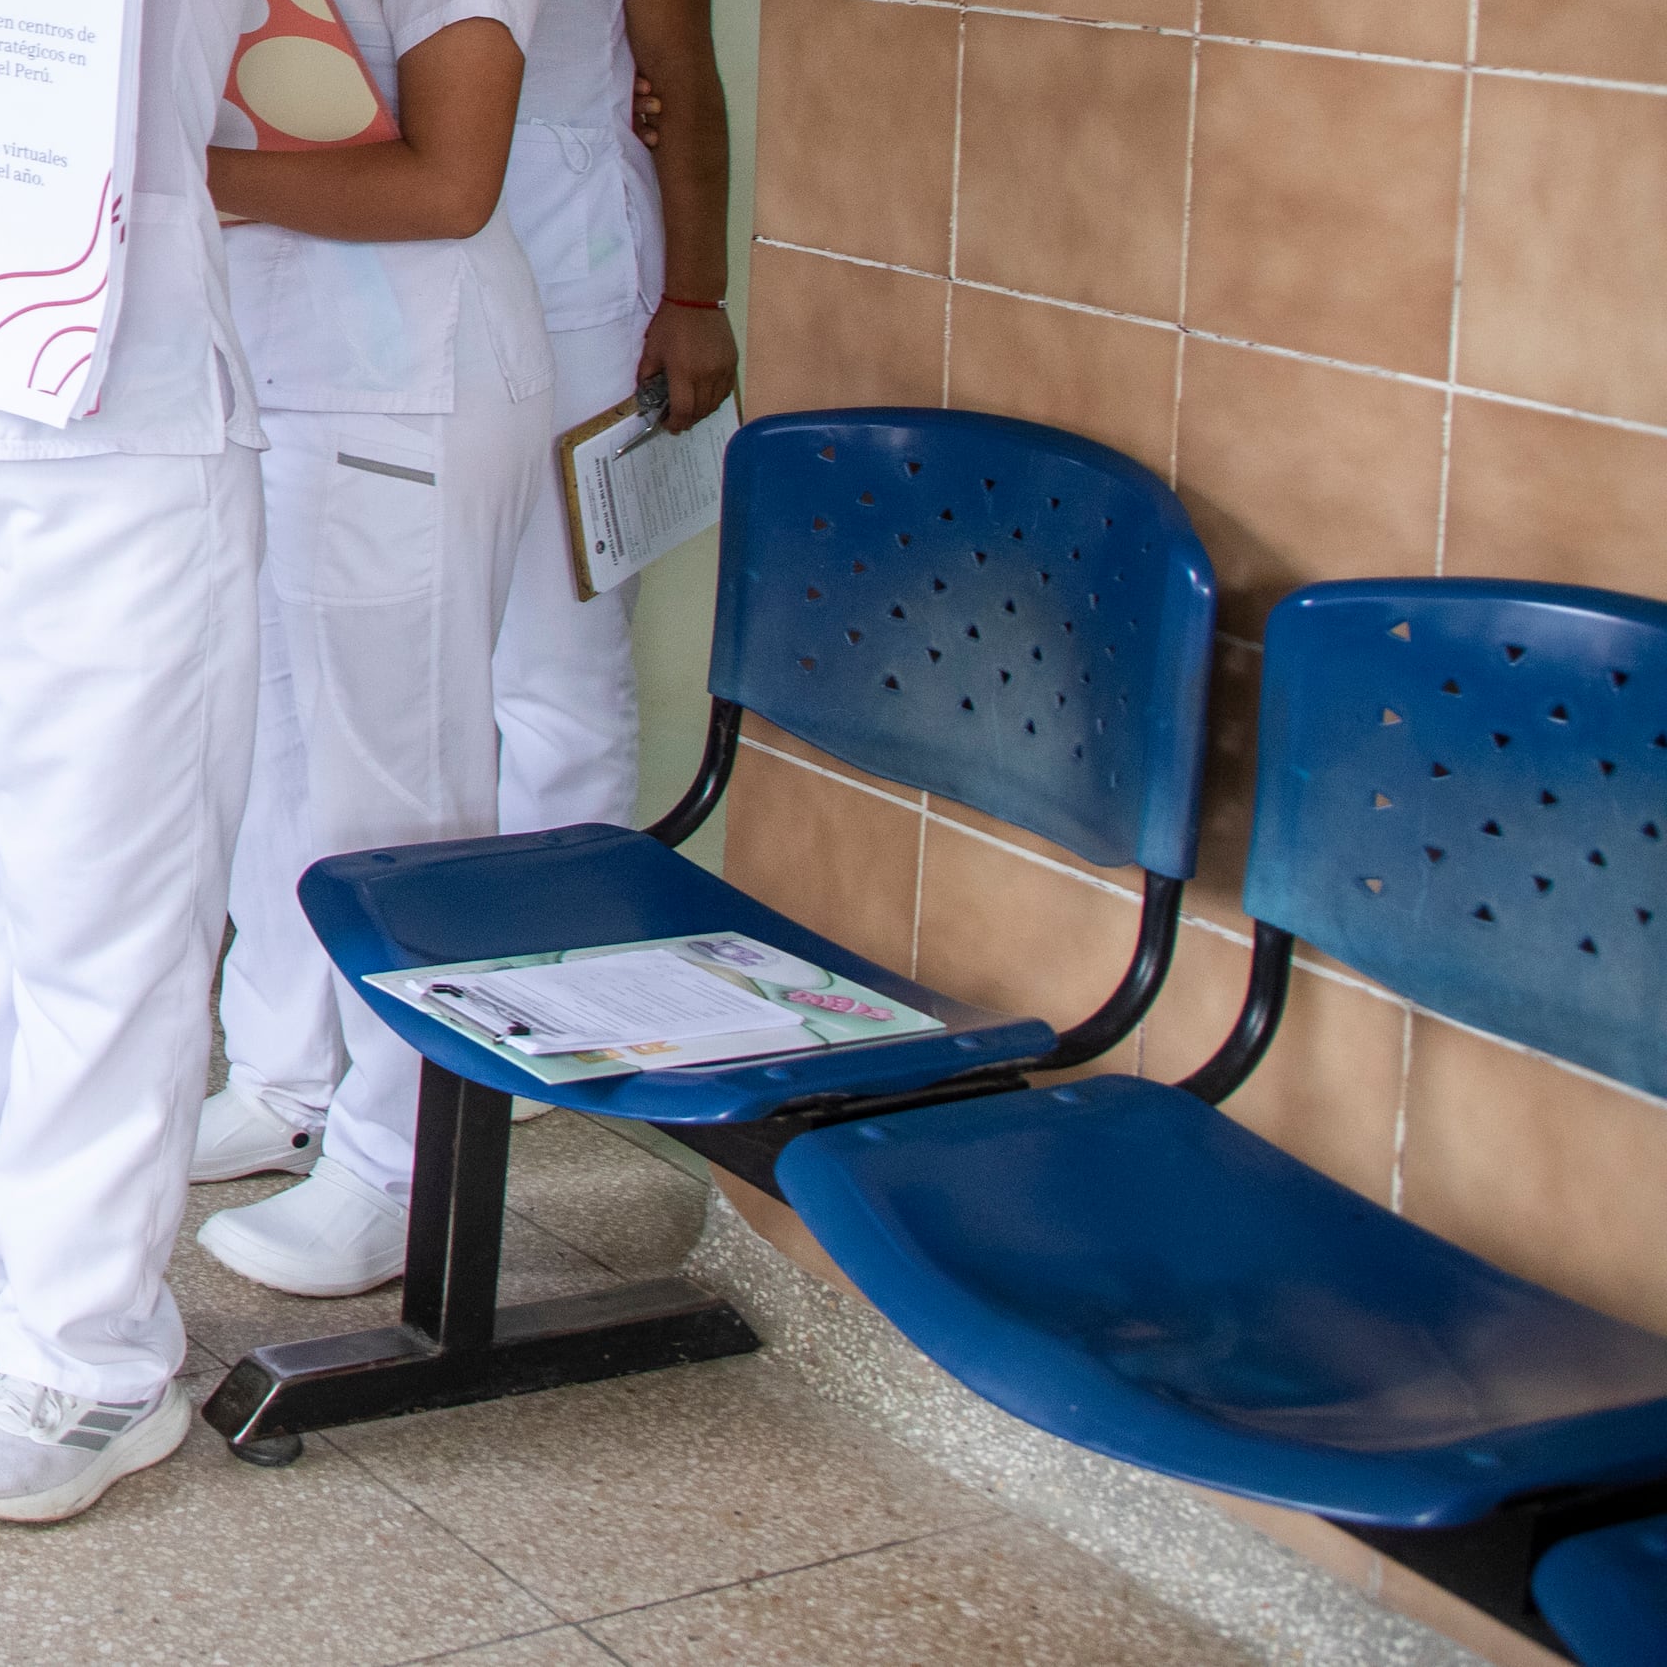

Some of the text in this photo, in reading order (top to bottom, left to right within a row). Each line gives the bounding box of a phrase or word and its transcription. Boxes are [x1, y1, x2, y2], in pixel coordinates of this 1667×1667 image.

[18, 18, 75, 40] centros
[77, 26, 96, 44] de
[68, 52, 87, 67] en
[14, 62, 54, 84] Perú.
[3, 141, 68, 168] virtuales
[13, 168, 46, 186] año.
